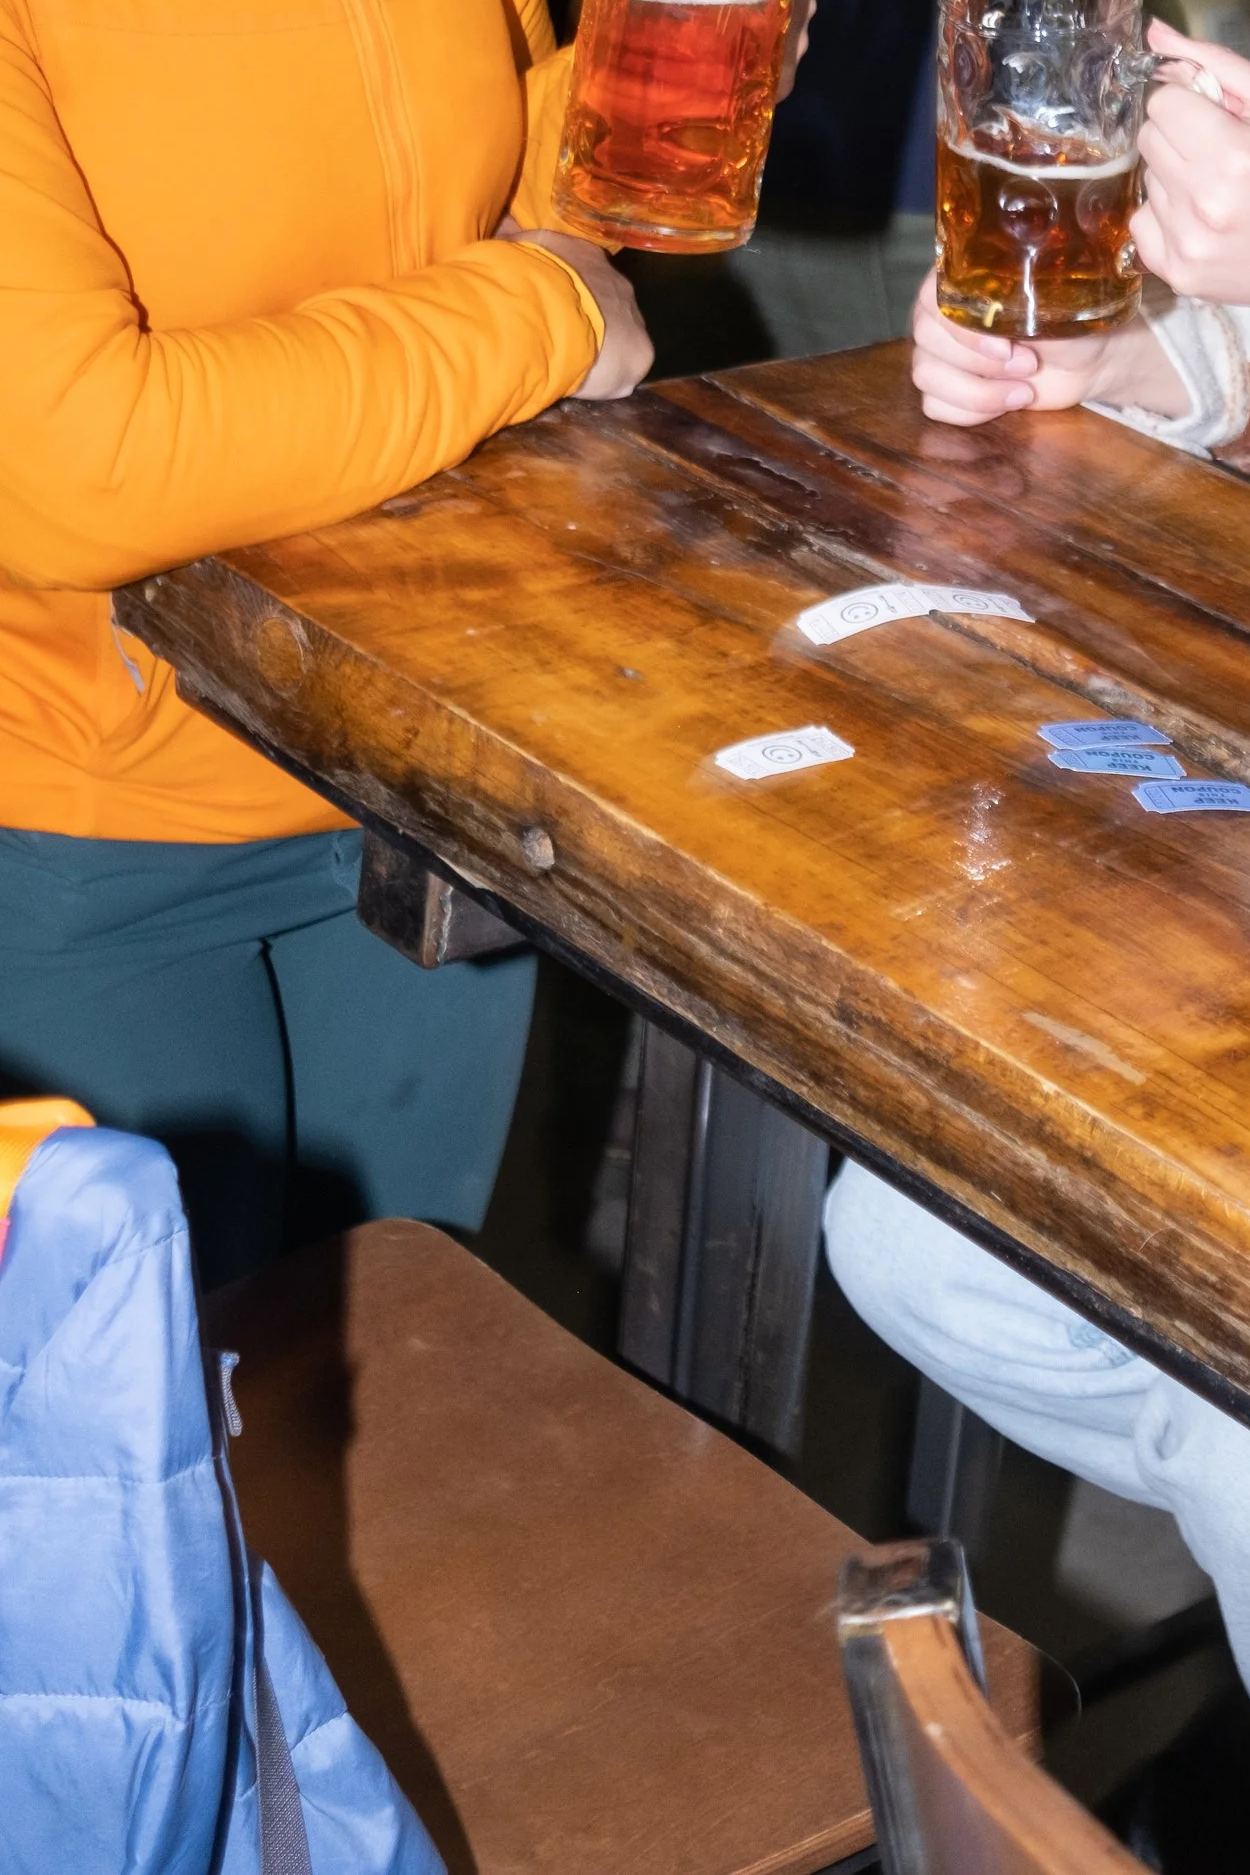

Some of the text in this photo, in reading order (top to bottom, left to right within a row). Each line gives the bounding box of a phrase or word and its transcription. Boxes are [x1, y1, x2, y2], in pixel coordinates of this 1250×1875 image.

[1085, 750, 1156, 761] COUPON
[1107, 763, 1153, 772] KEEP
[1170, 786, 1242, 795] COUPON
[1194, 797, 1240, 806] KEEP
